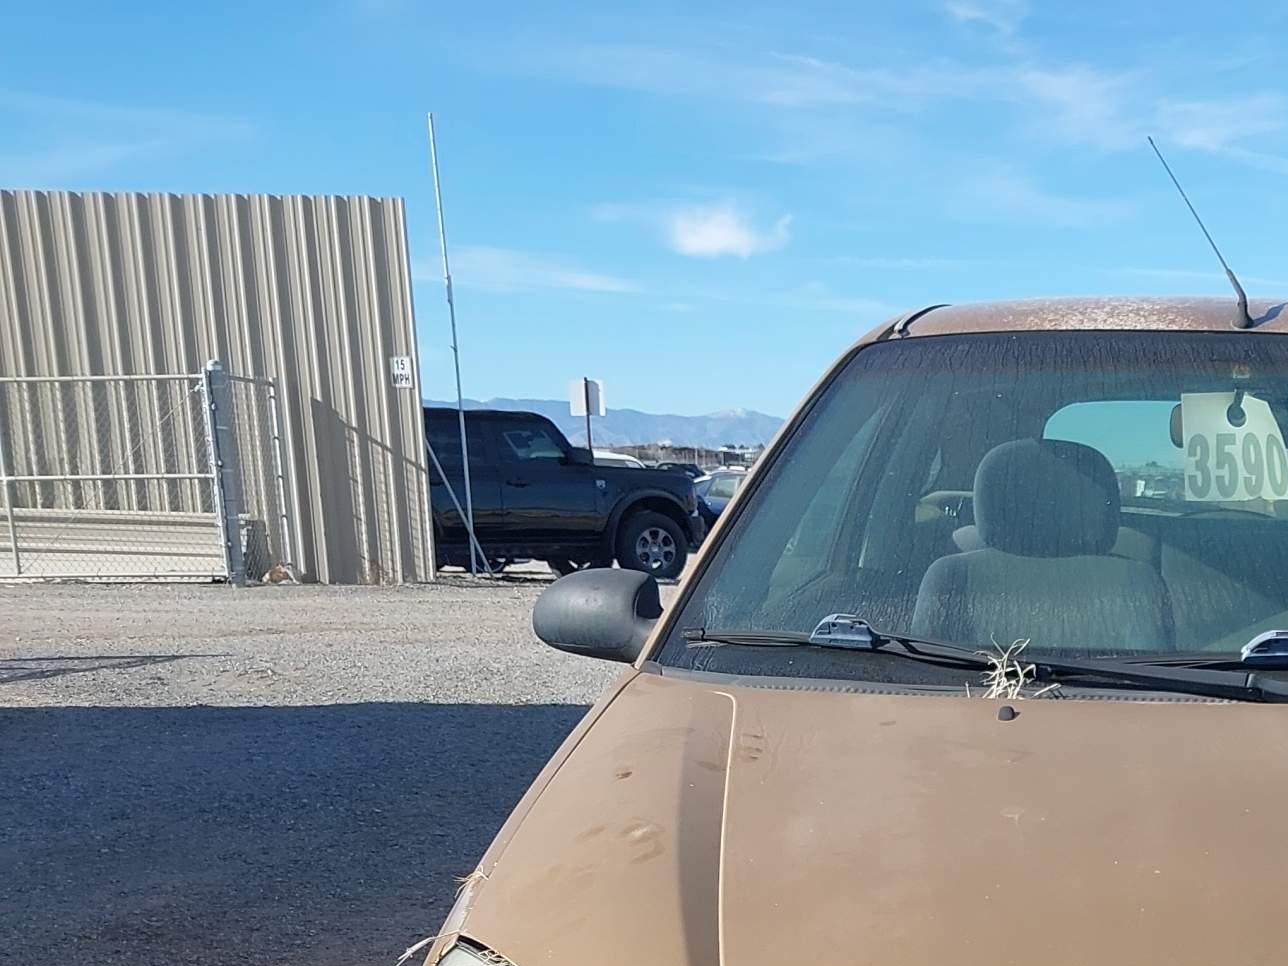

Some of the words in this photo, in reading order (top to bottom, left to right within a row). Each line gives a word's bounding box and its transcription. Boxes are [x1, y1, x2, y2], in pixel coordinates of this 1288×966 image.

[395, 359, 405, 370] 15
[392, 373, 410, 384] MPH
[1188, 432, 1288, 498] 3590
